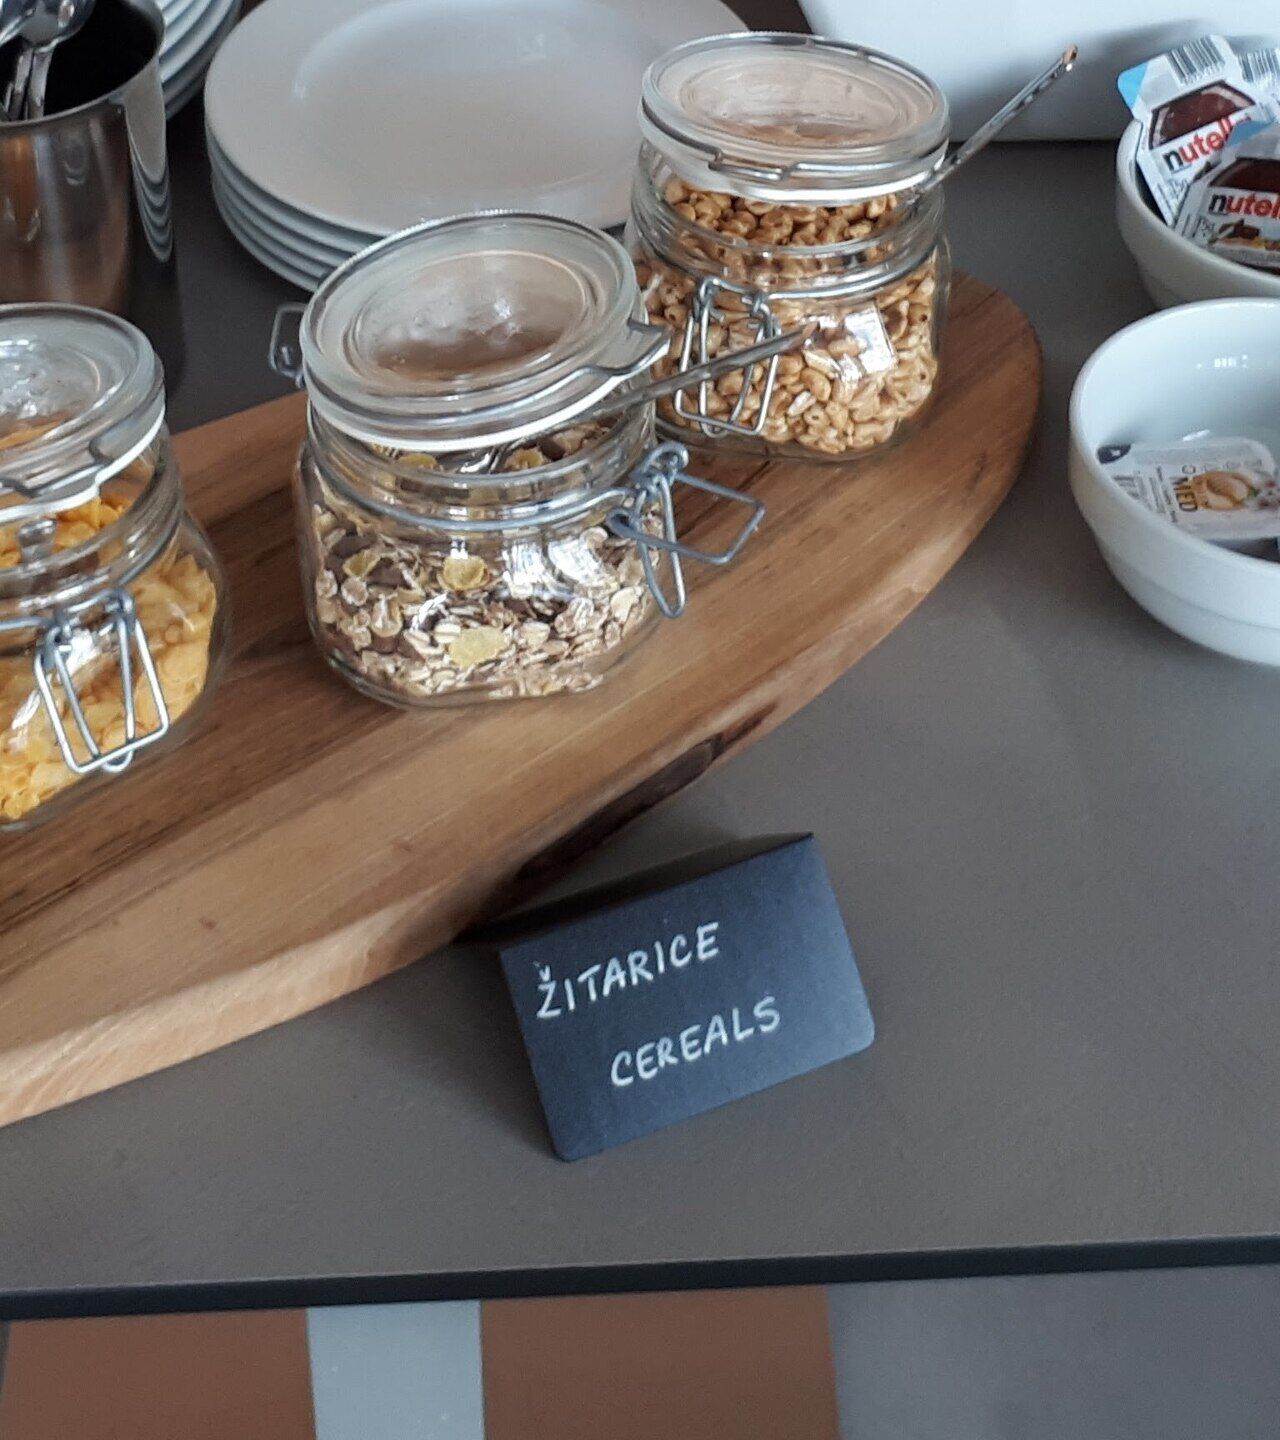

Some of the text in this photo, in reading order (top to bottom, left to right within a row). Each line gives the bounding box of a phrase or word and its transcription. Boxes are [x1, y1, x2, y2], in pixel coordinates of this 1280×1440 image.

[1163, 116, 1249, 171] nutell
[534, 921, 720, 1020] ŽITARICE
[610, 995, 782, 1087] CEREALS
